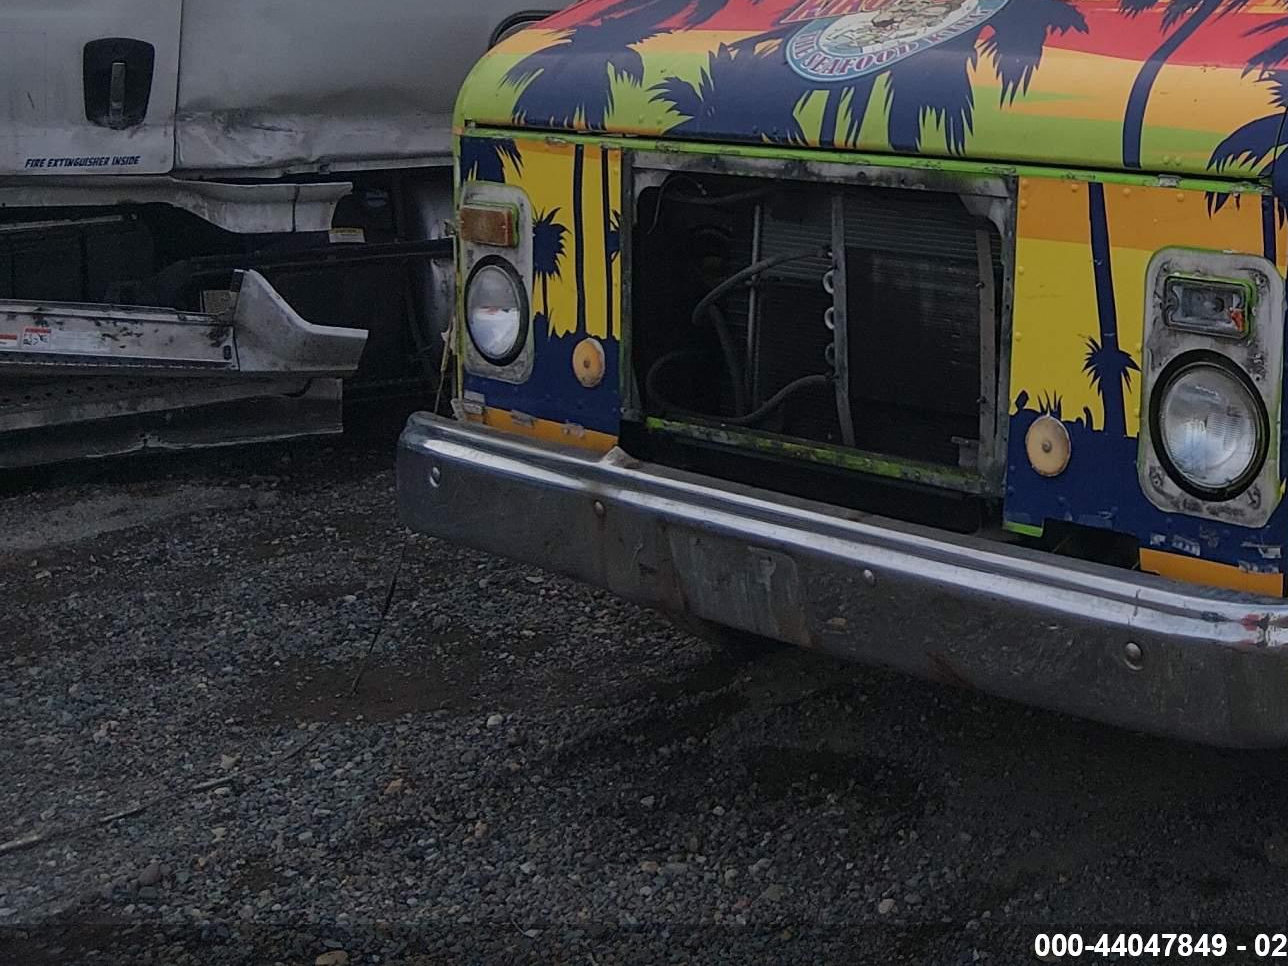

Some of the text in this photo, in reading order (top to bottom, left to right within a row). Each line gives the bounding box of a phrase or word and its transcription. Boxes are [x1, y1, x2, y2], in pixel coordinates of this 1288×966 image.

[801, 42, 921, 75] SEAFOOD
[25, 155, 141, 168] FIRE EXTINGUISHER INSIDE
